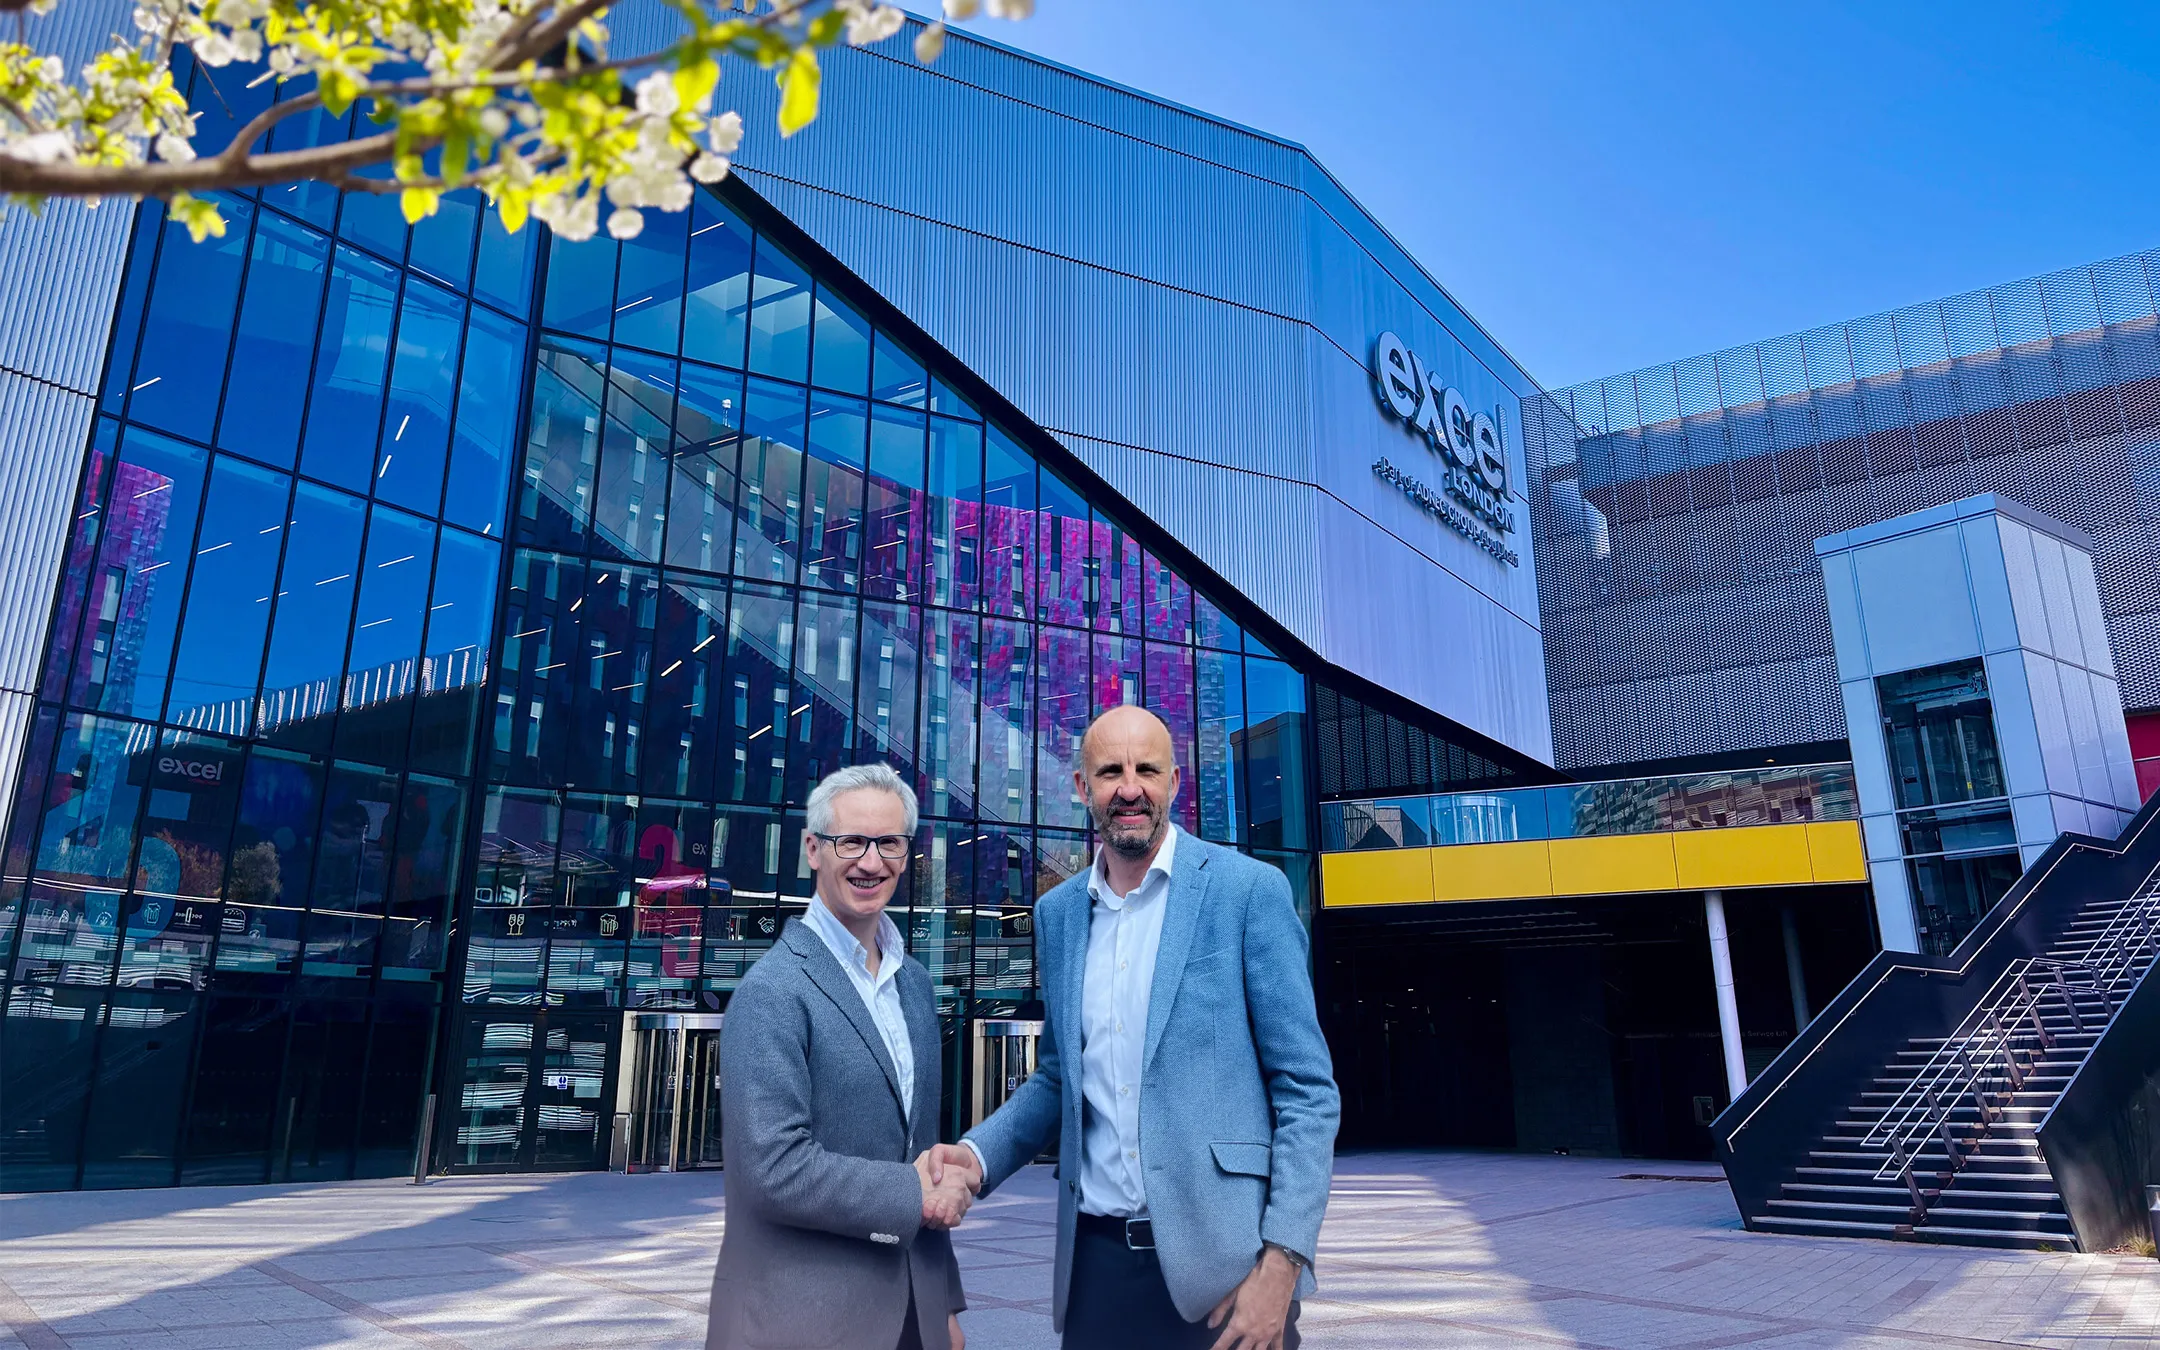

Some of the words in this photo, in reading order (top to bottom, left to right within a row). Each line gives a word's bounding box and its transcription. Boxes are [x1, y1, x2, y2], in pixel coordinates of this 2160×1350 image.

[1375, 330, 1515, 503] excel
[1449, 466, 1516, 534] LONDON
[1448, 505, 1480, 538] GROUP
[158, 757, 223, 780] excel
[692, 842, 725, 859] exel
